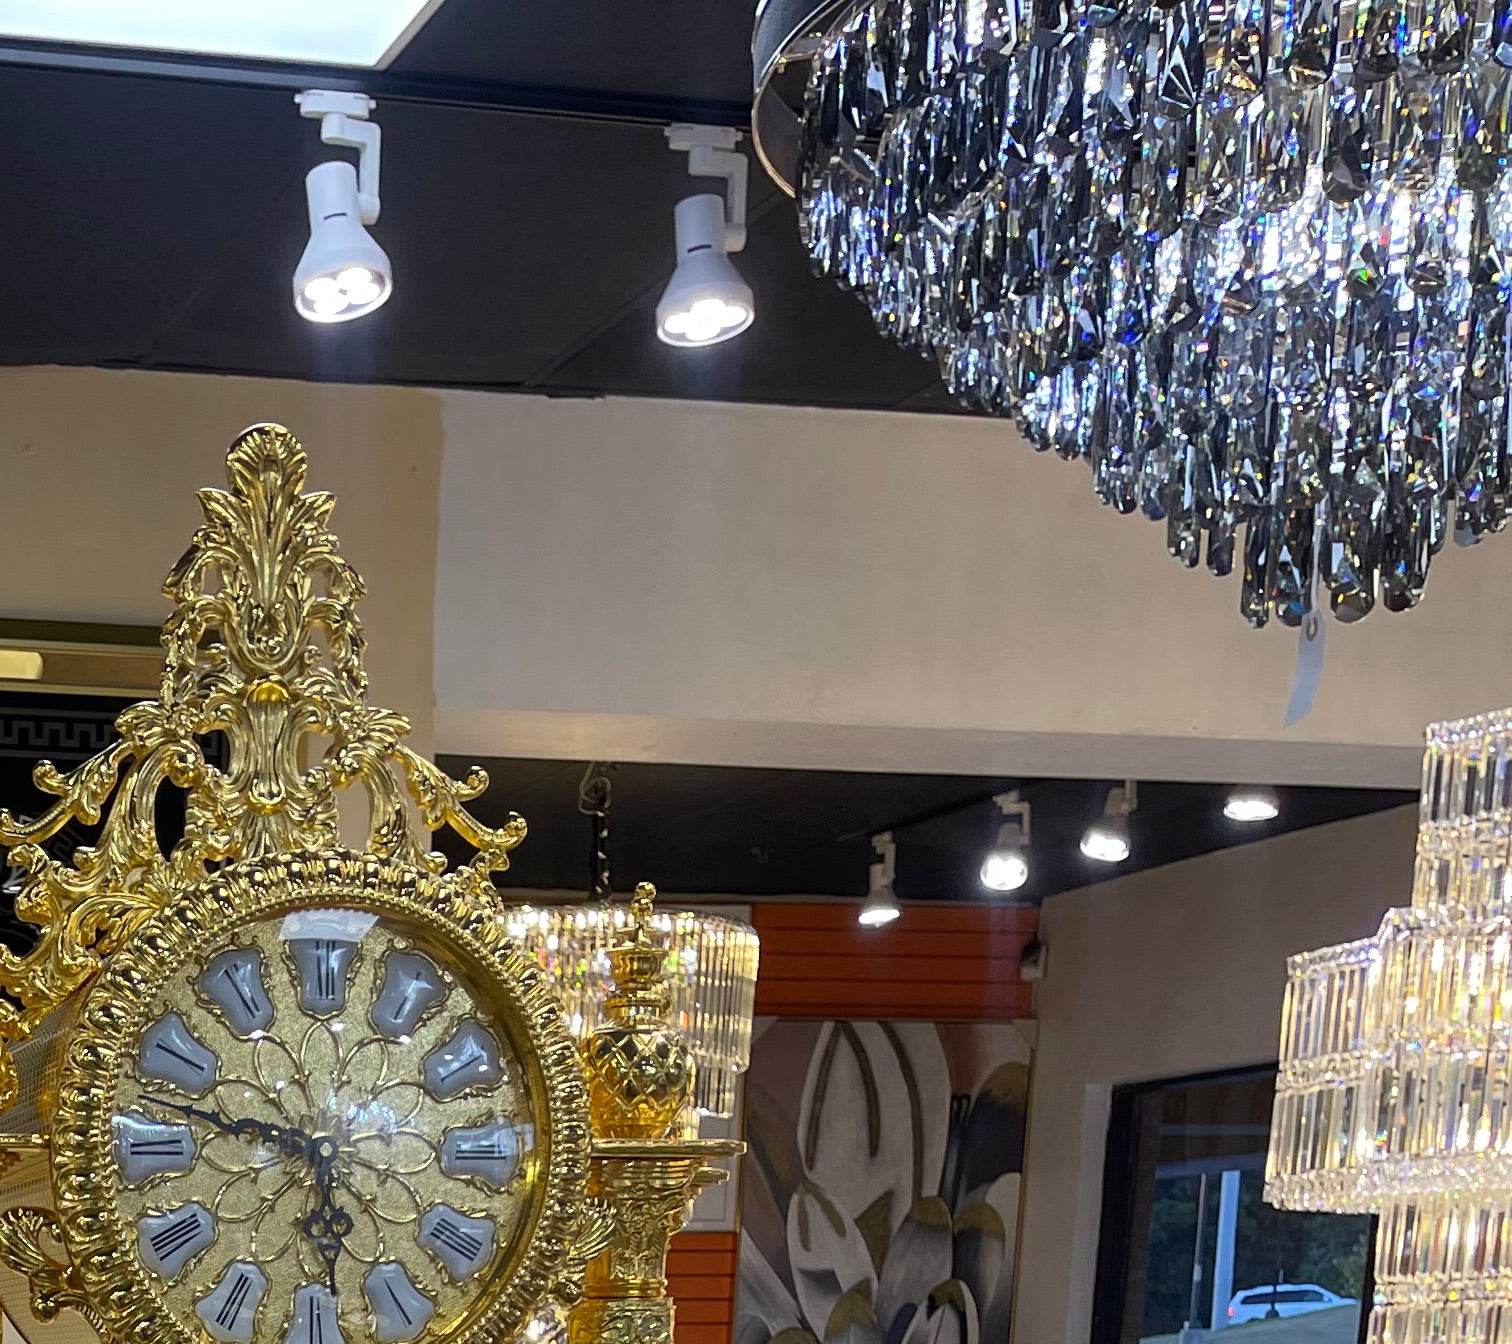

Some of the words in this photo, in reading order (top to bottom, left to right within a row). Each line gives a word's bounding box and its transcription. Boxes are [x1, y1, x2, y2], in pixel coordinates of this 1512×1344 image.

[223, 962, 261, 1022] XI
[314, 940, 337, 1000] XII
[394, 970, 423, 1021] I
[155, 1037, 206, 1077] X
[130, 1139, 184, 1156] IX
[150, 1212, 204, 1262] VIII
[430, 1217, 483, 1262] IIII
[215, 1272, 254, 1331] VII
[384, 1277, 413, 1329] V
